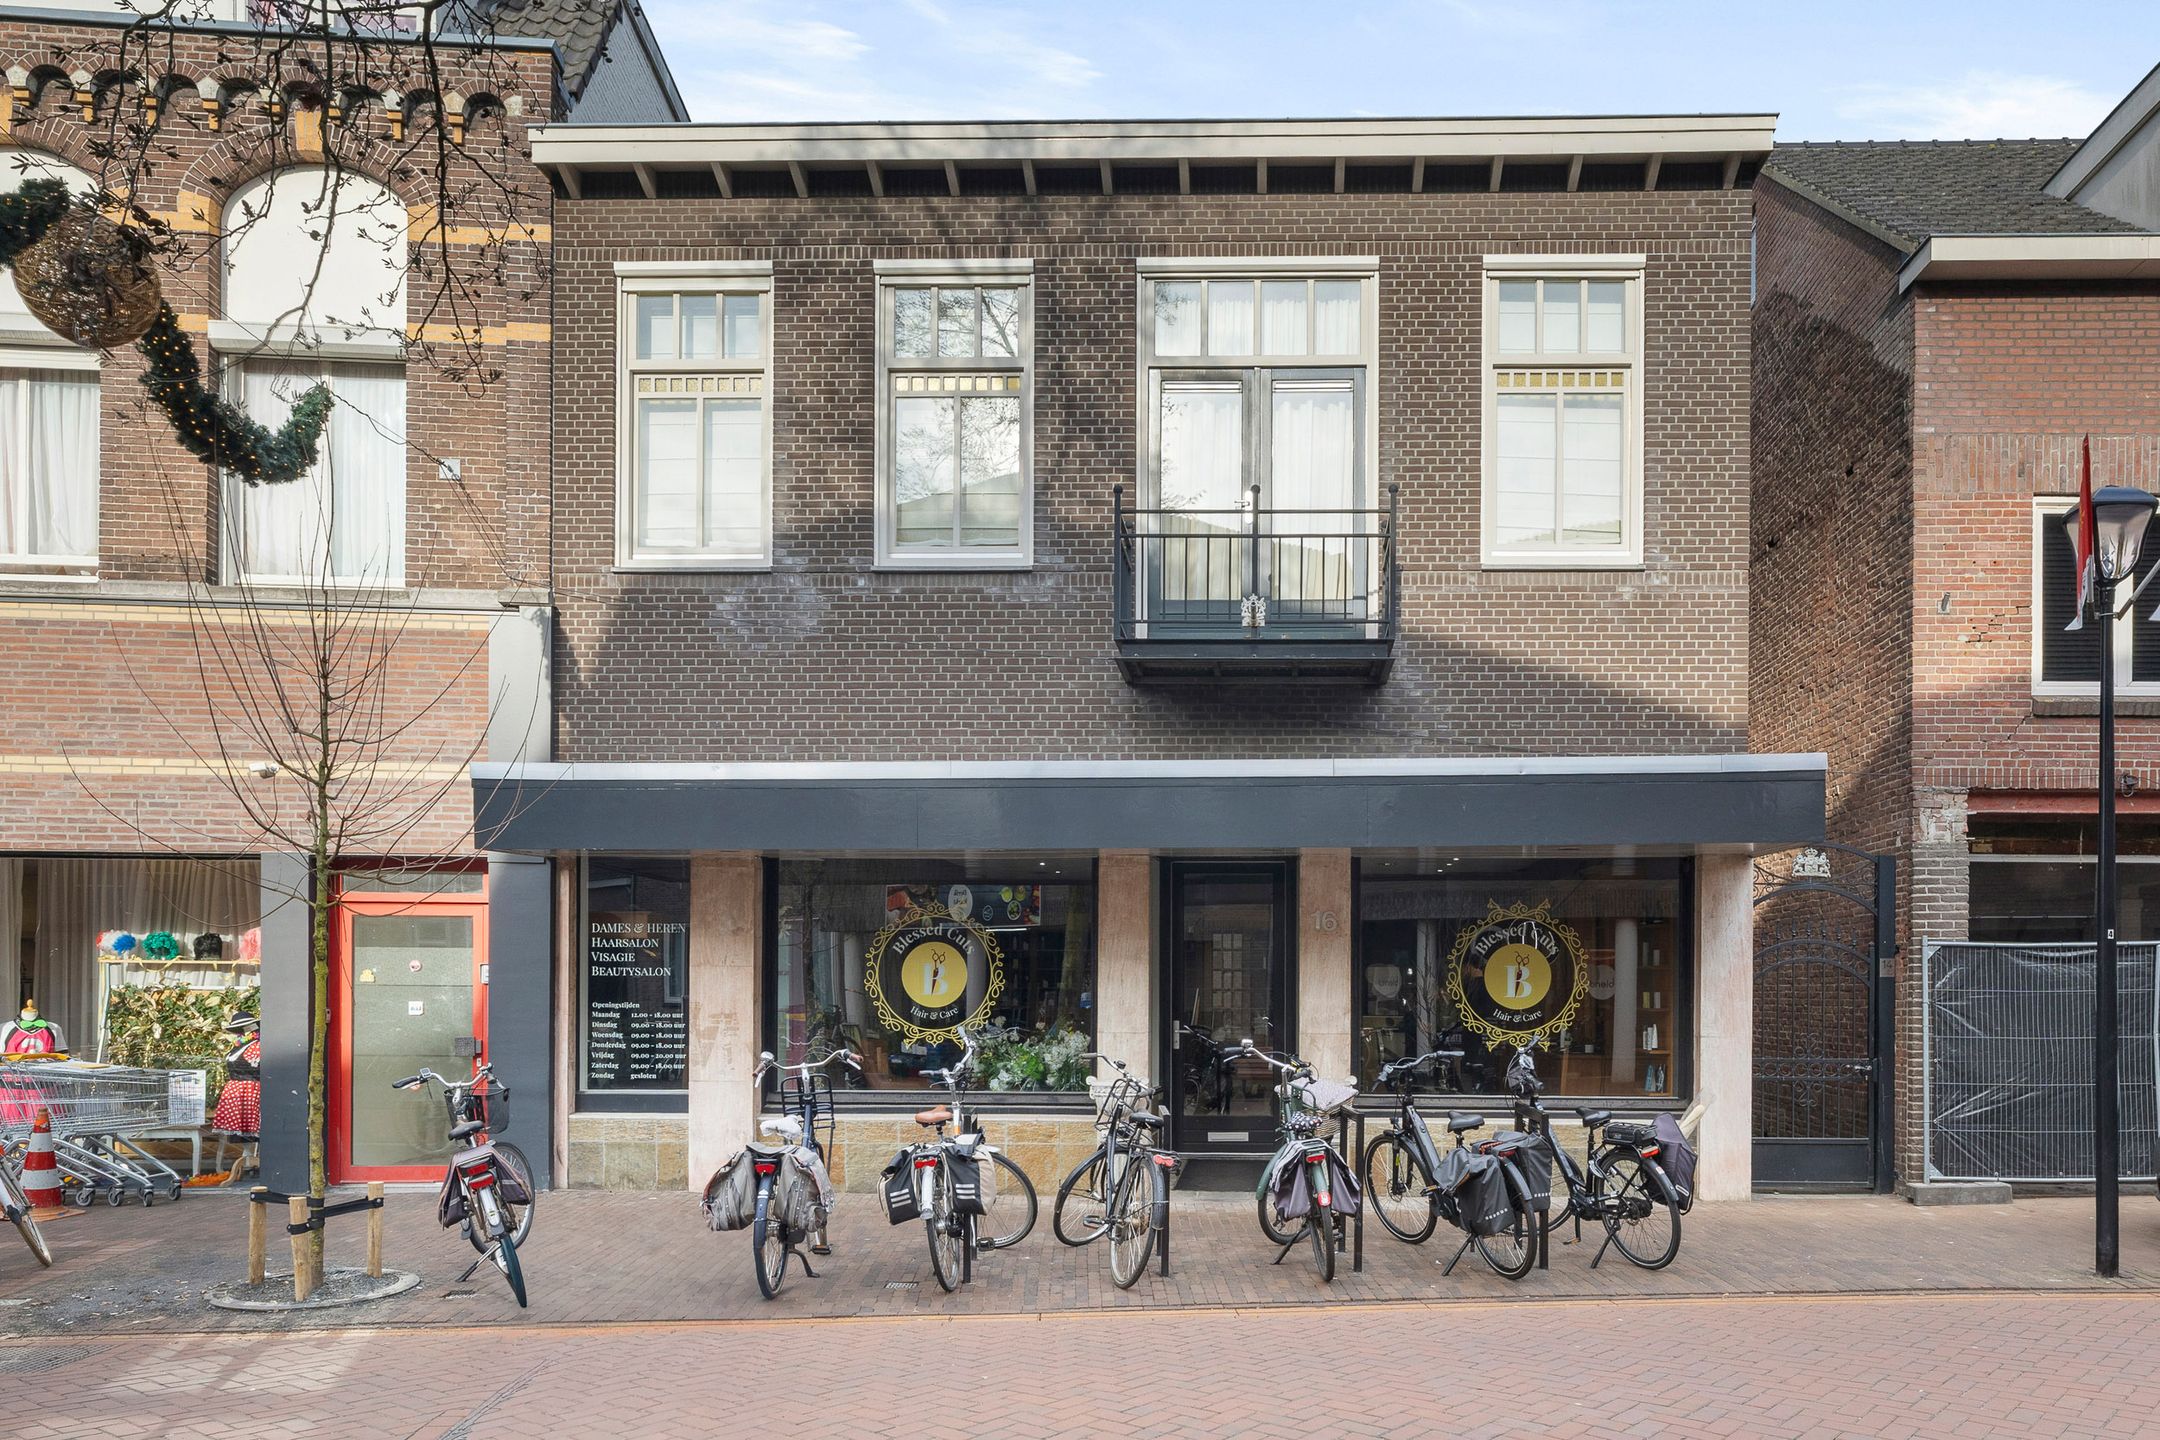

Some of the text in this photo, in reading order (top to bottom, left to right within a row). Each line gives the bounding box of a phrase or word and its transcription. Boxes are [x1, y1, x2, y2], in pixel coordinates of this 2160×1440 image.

[1311, 910, 1338, 932] 16
[592, 922, 686, 934] DAMES & HEREN
[592, 937, 659, 948] HAARSALON
[892, 923, 974, 954] Blessed Cuts
[1475, 924, 1560, 955] Blessed Cuts
[591, 952, 636, 962] VISAGIE
[592, 966, 672, 976] BEAUTYSALON
[922, 963, 948, 996] B
[1504, 965, 1532, 998] B
[910, 1006, 928, 1018] Hair
[940, 1008, 958, 1019] Care
[1493, 1009, 1512, 1021] Hair
[1522, 1010, 1542, 1022] Care
